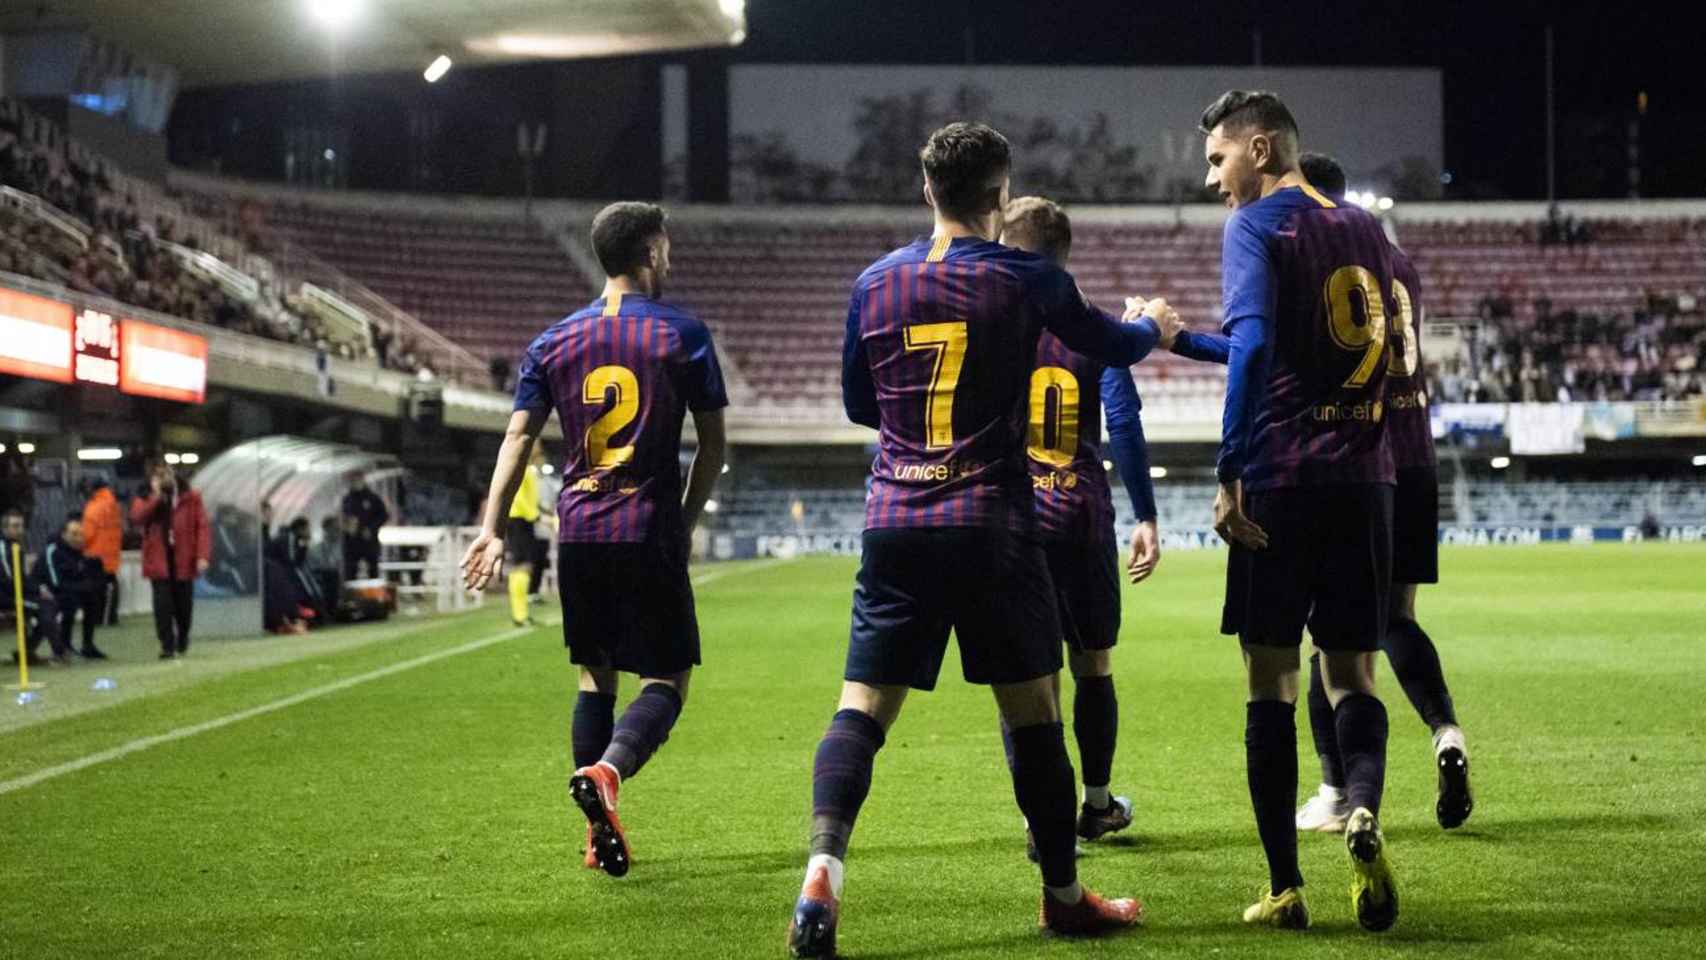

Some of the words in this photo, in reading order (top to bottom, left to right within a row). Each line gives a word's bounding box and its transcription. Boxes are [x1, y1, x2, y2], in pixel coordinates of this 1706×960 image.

[1324, 265, 1385, 388] 9
[582, 364, 640, 470] 2
[903, 321, 968, 451] 7
[1313, 401, 1372, 422] unicef
